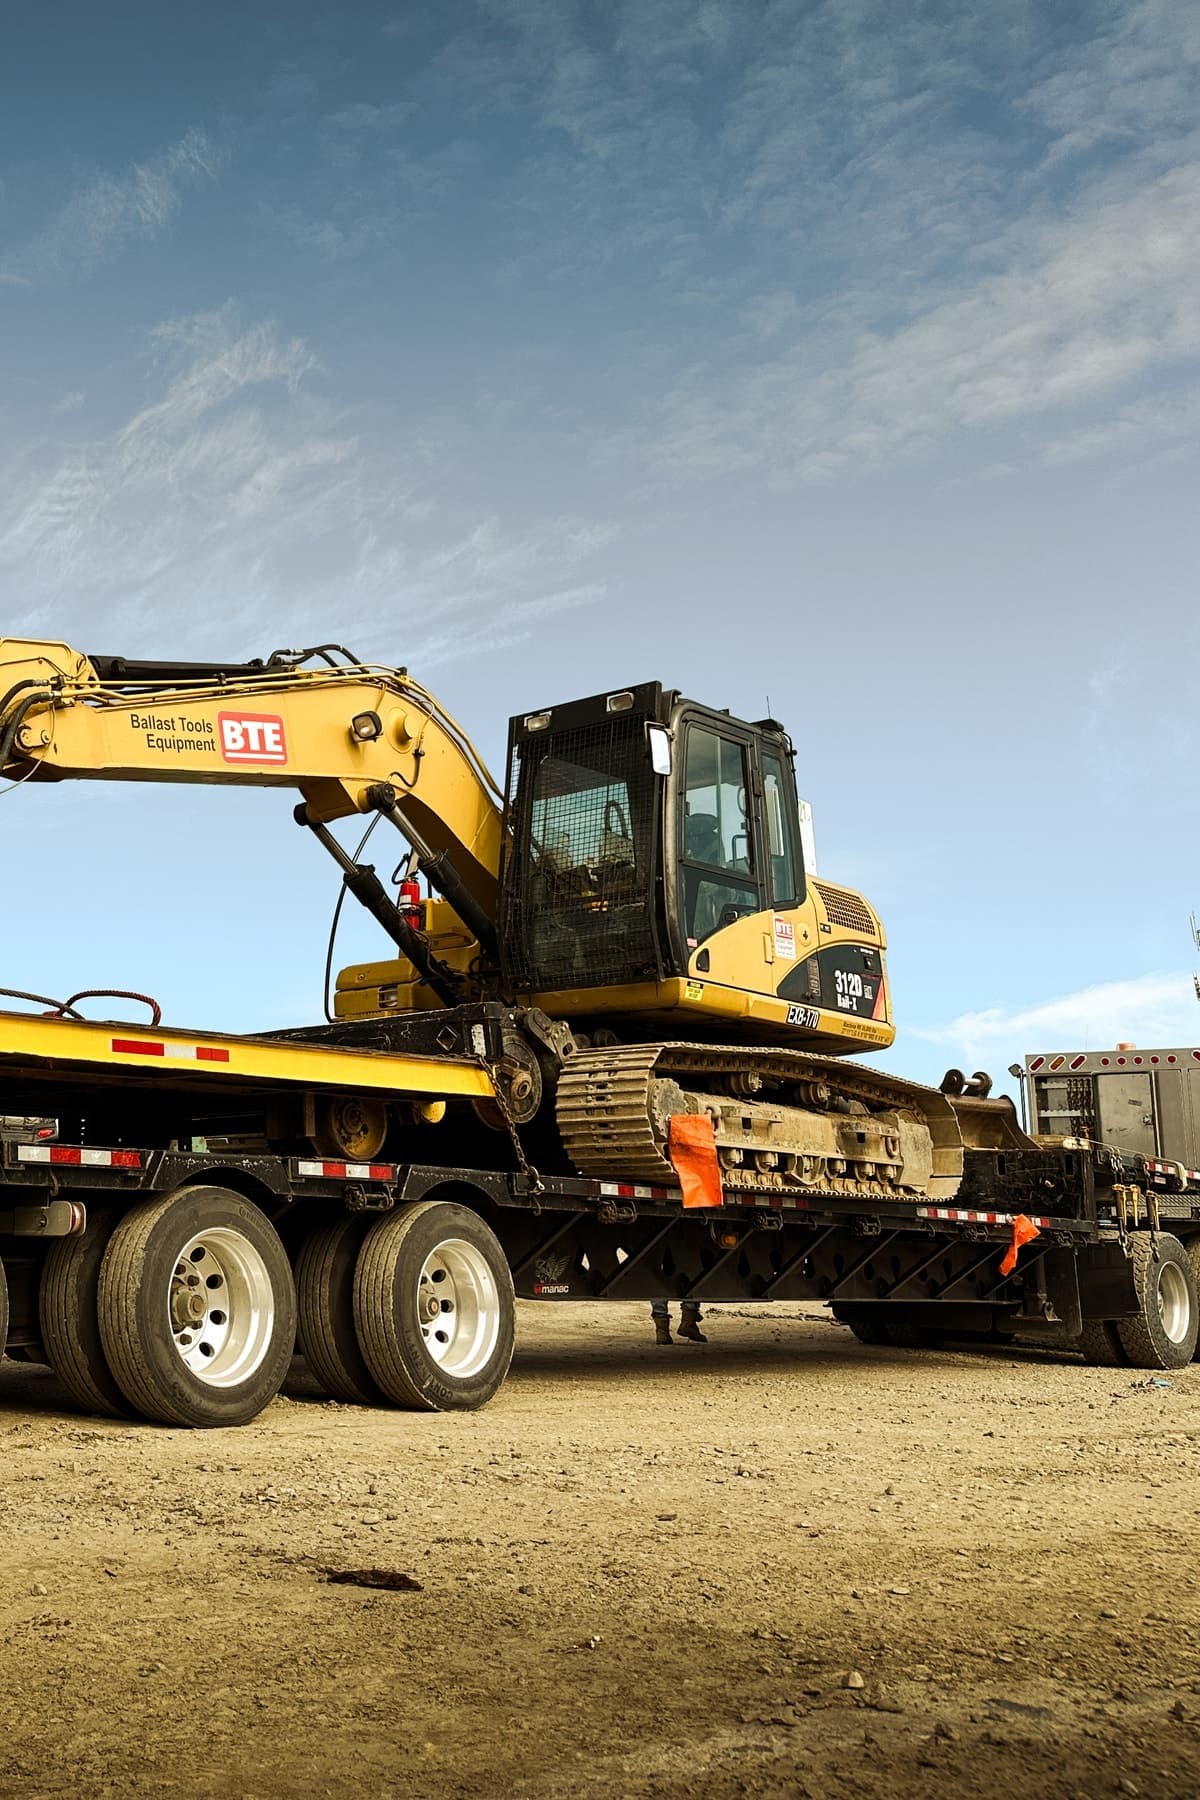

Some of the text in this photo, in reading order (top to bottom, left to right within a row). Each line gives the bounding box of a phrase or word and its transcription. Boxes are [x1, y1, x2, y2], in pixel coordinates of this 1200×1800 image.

[130, 713, 213, 734] Ballast Tools
[146, 733, 216, 753] Equipment
[221, 719, 284, 753] BTE
[834, 969, 863, 998] 312D
[787, 1005, 820, 1029] EXB-170
[542, 1285, 569, 1294] manac
